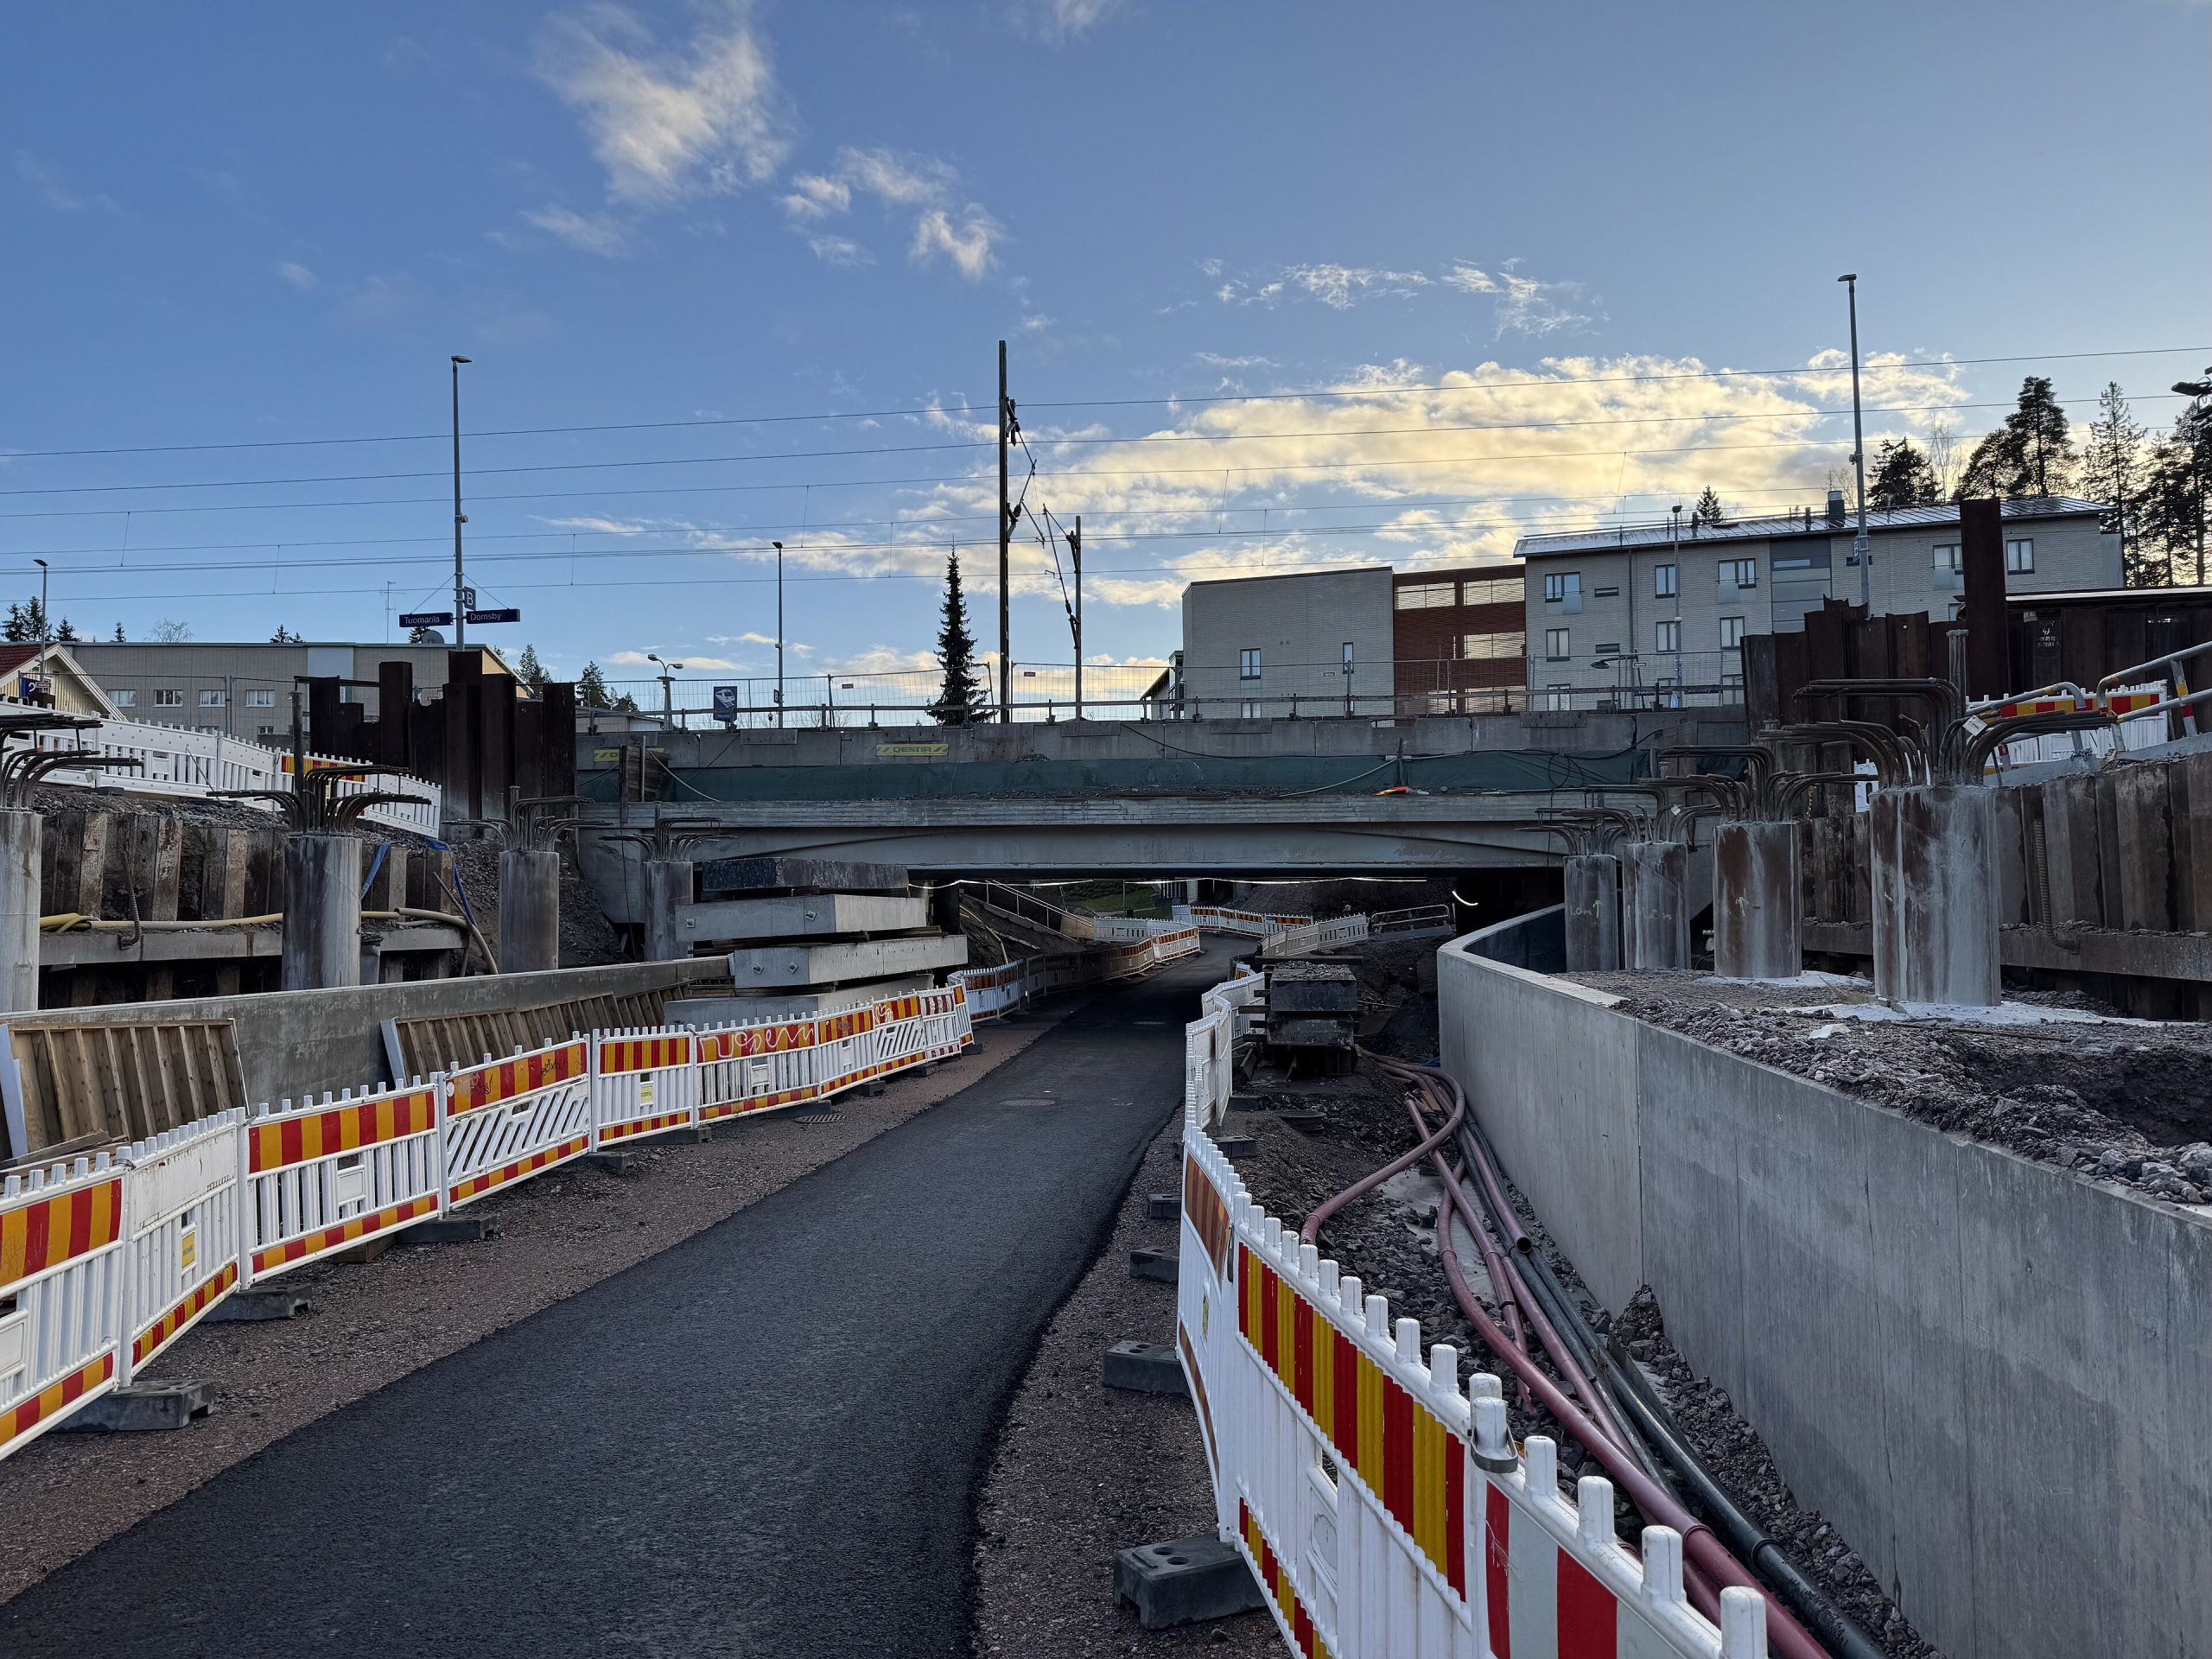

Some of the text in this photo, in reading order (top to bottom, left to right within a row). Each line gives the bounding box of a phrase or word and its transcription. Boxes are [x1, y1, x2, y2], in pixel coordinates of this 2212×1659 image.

[467, 592, 474, 606] B
[404, 615, 440, 624] Tuomarila
[470, 613, 501, 621] Domsby
